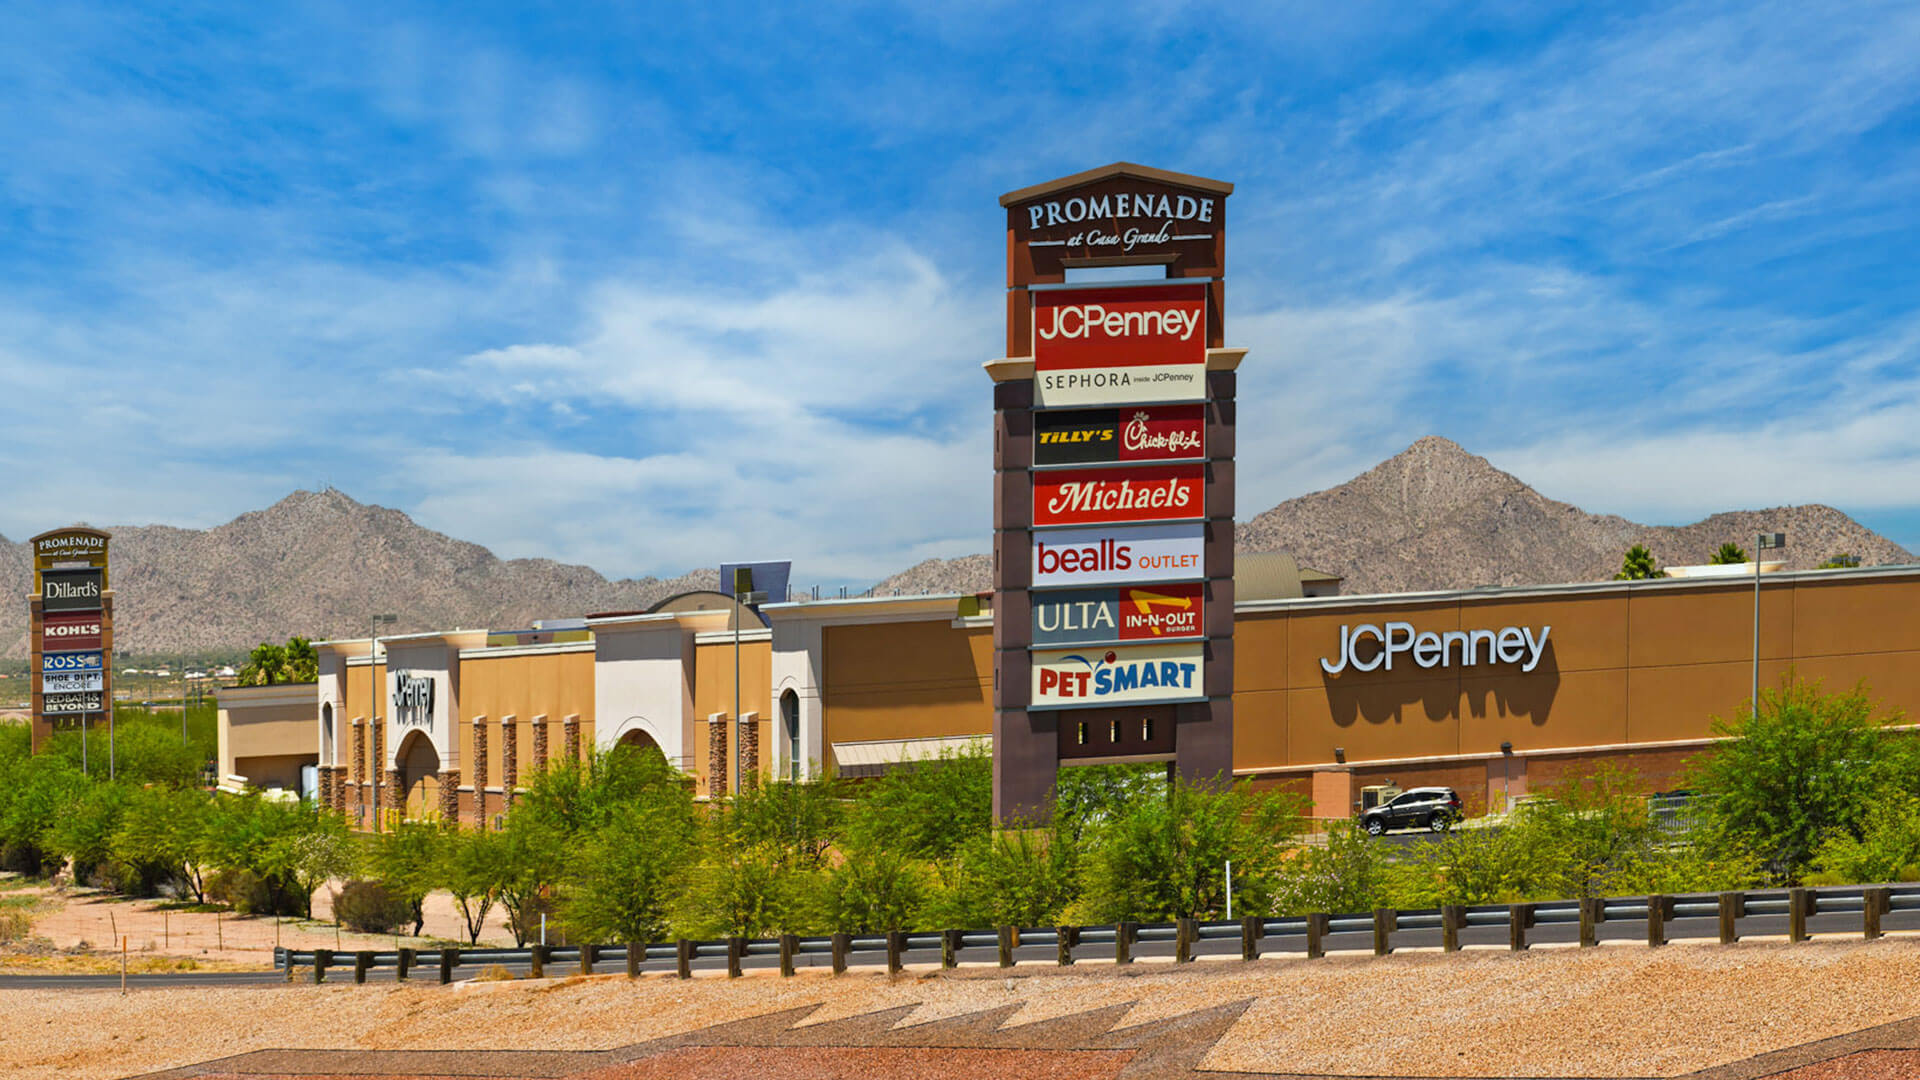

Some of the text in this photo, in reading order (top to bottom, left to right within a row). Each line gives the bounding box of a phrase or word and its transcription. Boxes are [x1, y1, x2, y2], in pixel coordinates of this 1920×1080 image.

[1028, 193, 1215, 230] PROMENADE
[1067, 219, 1173, 252] at Casa Grande
[1039, 304, 1201, 341] JCPenney
[1045, 373, 1131, 389] SEPHORA
[1152, 373, 1194, 383] JCPenney
[1124, 418, 1200, 452] Chick-fil-A
[1048, 477, 1191, 514] Michaels
[39, 536, 105, 551] PROMENADE
[1038, 538, 1199, 574] bealls OUTLET
[46, 581, 98, 599] Dillard's
[1038, 601, 1115, 631] ULTA
[1126, 612, 1196, 628] IN-N-OUT
[45, 624, 100, 637] KOHL'S
[1320, 621, 1551, 673] JCPenney
[44, 655, 86, 669] ROSS
[45, 674, 69, 682] SHOE
[46, 702, 100, 712] BEYOND
